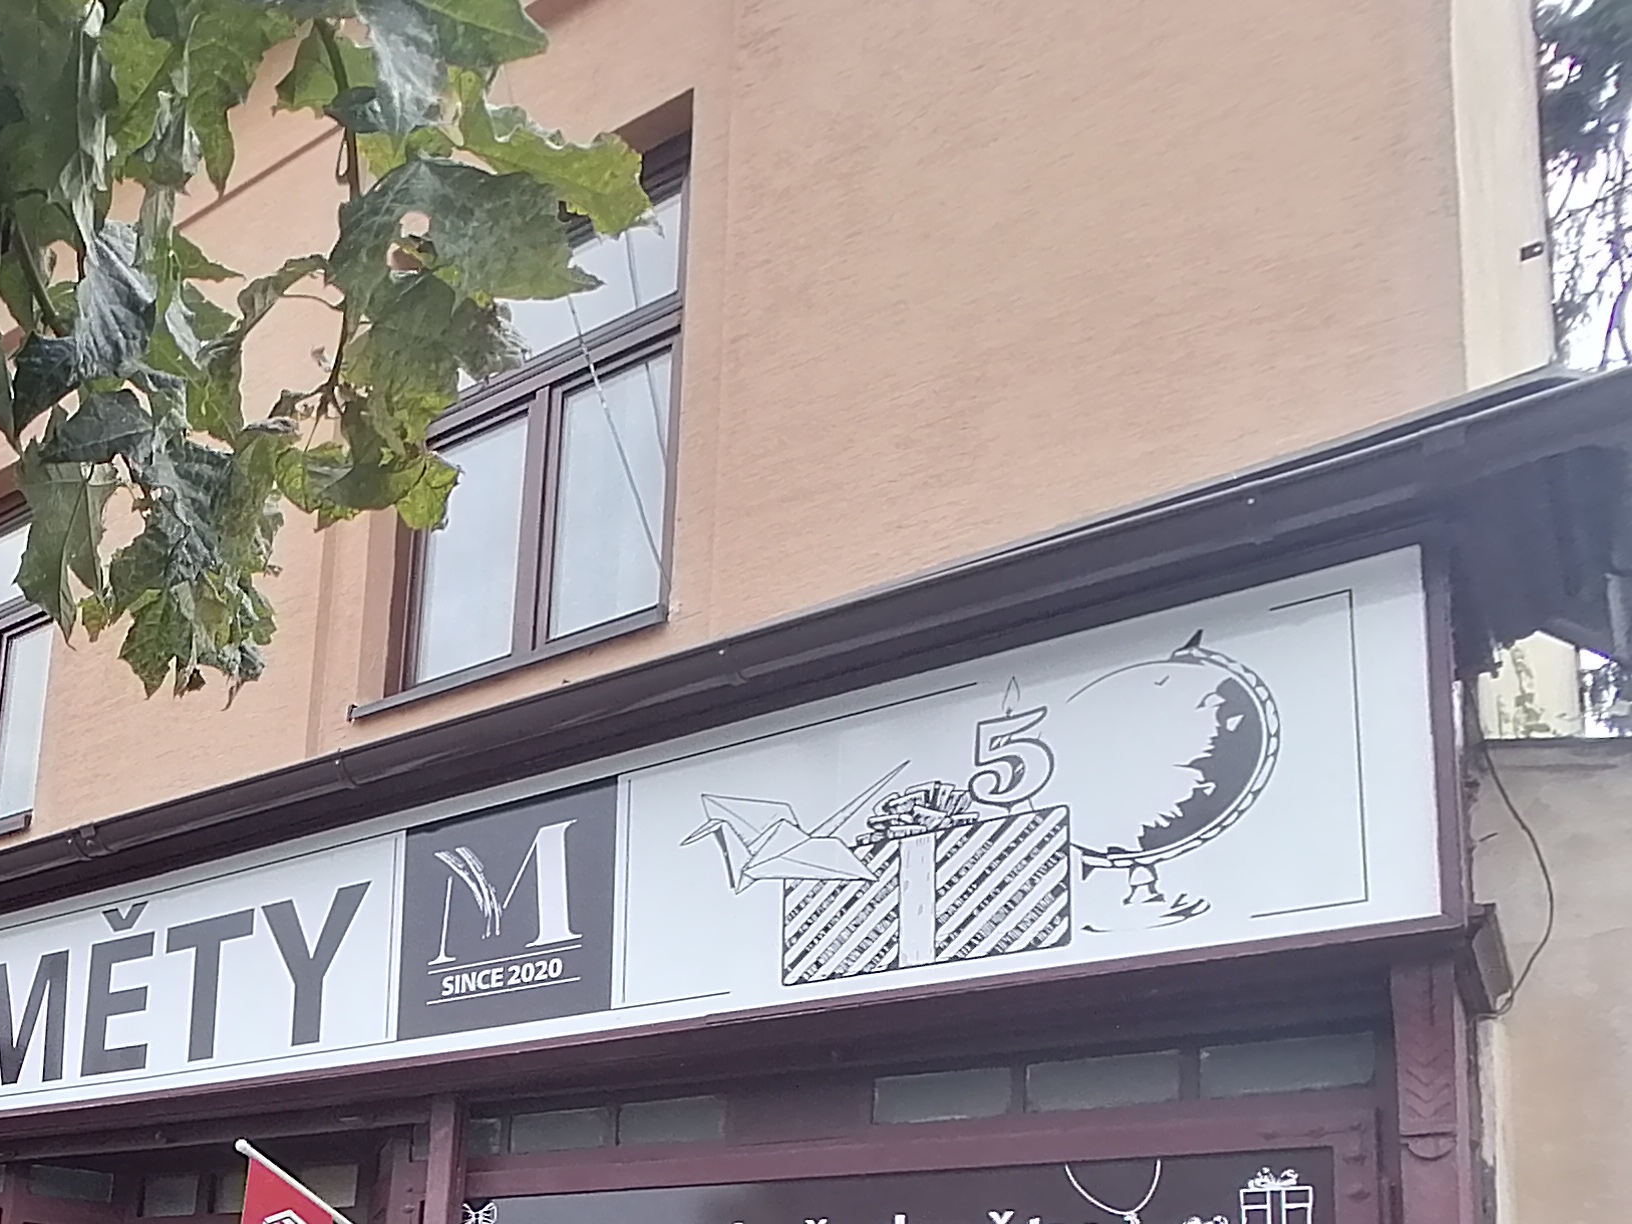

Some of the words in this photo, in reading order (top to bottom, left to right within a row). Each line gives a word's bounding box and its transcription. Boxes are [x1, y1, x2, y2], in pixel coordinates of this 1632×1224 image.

[427, 819, 582, 965] M
[441, 966, 504, 997] SINCE
[508, 957, 563, 987] 2020
